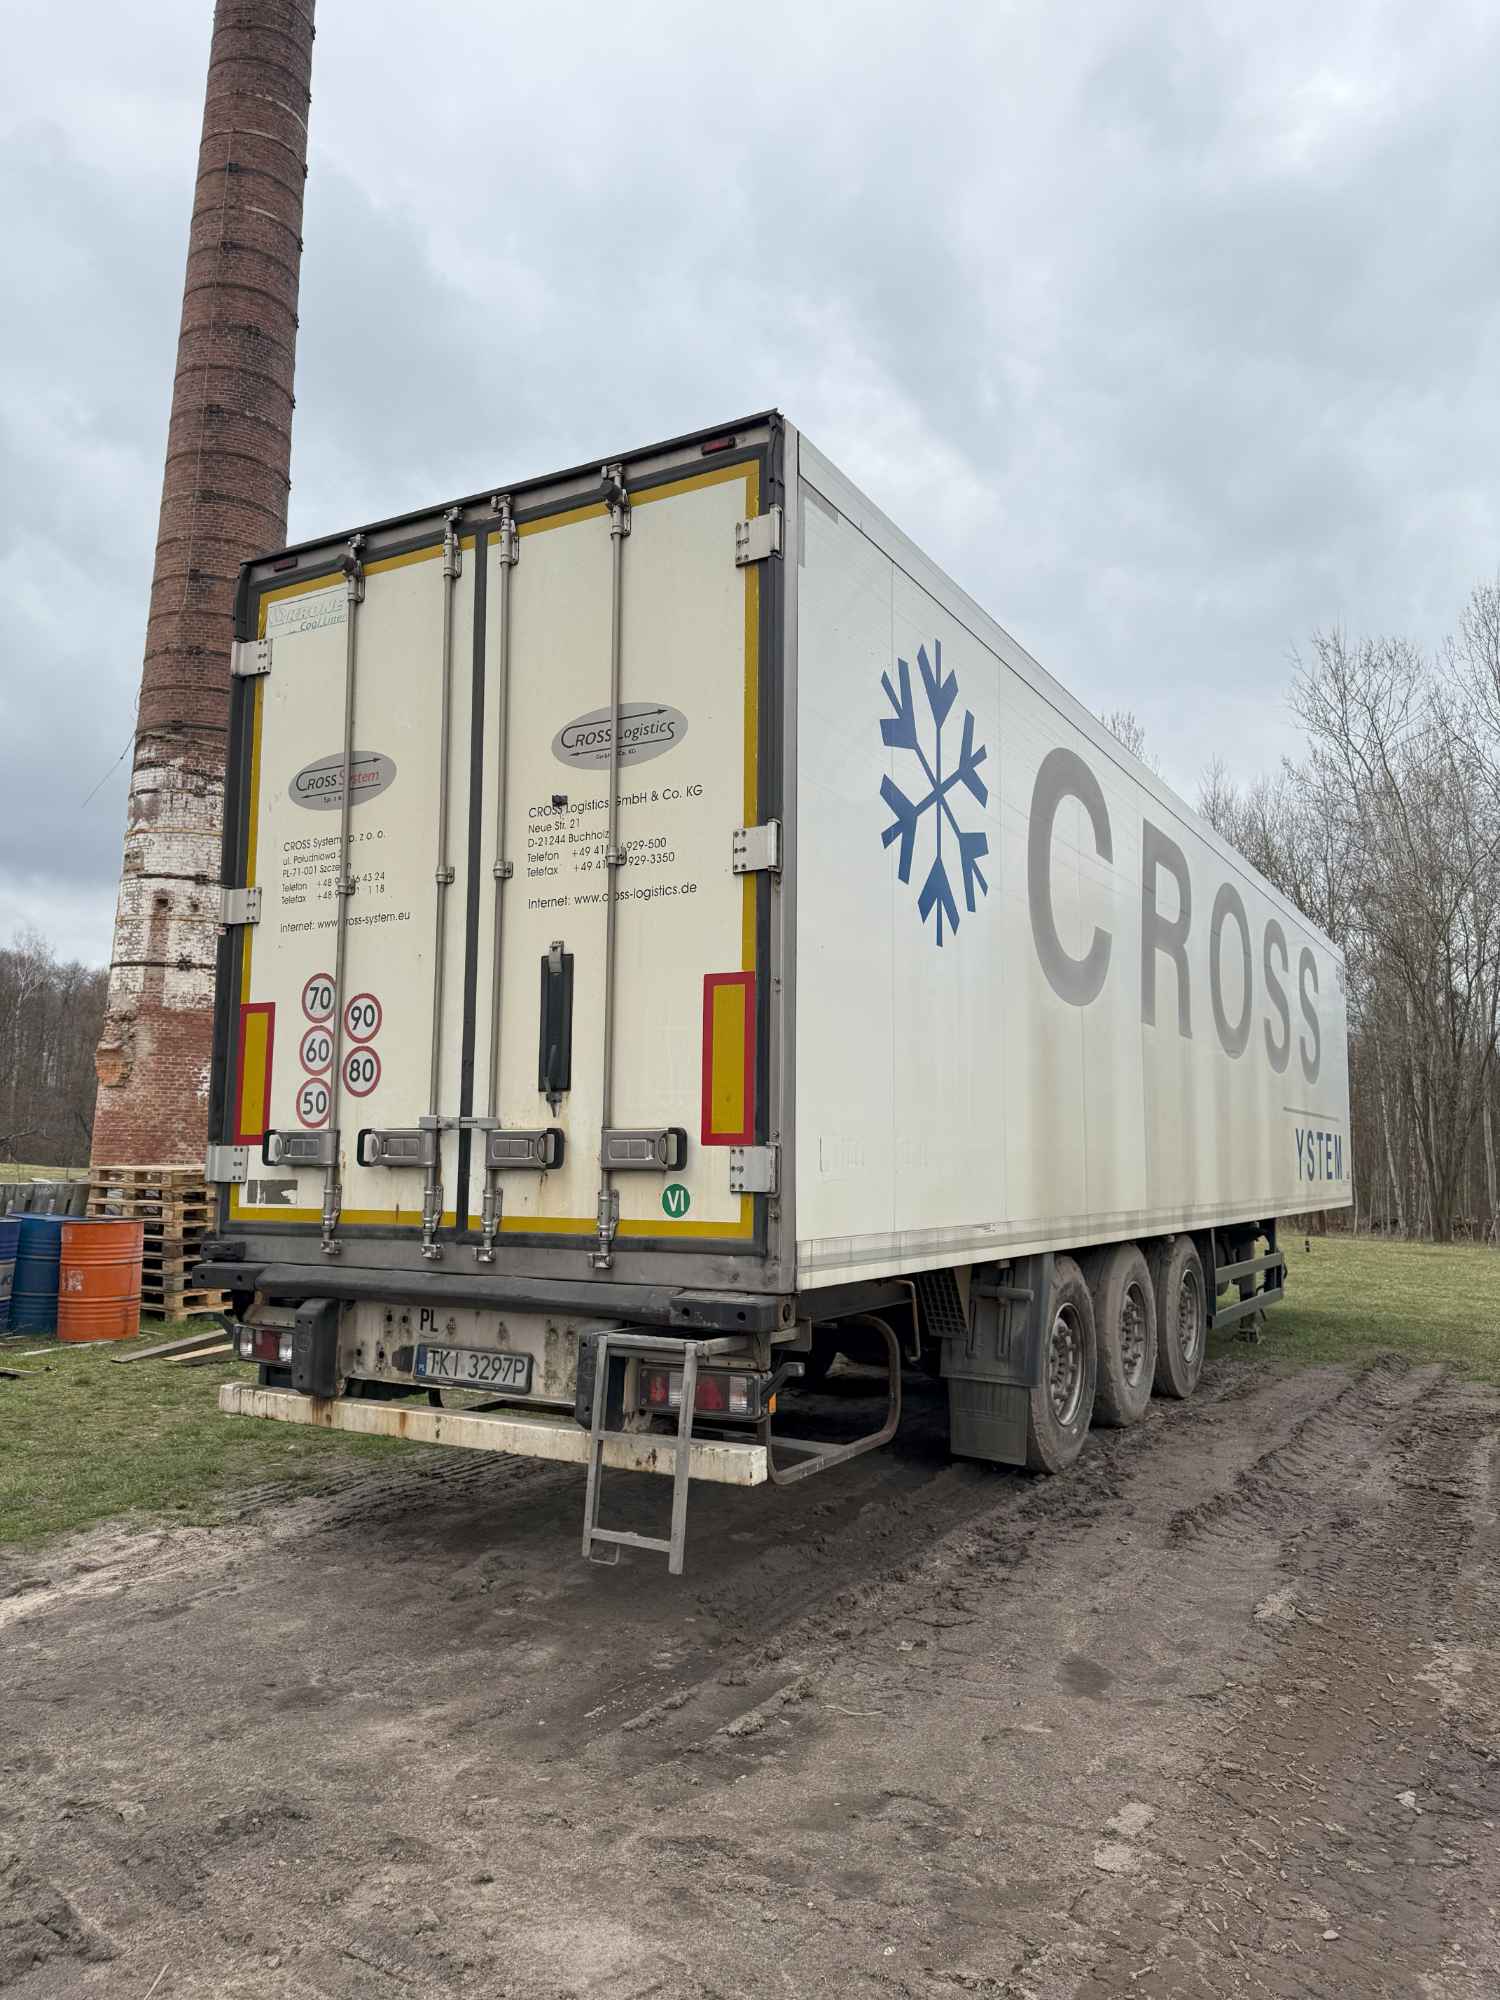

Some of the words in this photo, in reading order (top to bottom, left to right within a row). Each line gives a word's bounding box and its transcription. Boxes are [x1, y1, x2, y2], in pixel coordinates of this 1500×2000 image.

[560, 726, 612, 749] CROSS
[616, 720, 676, 743] ogistics
[296, 771, 337, 791] CROSS
[338, 767, 380, 786] Sstem
[528, 804, 563, 819] CROSS
[566, 798, 609, 816] Logistics
[650, 790, 660, 802] &
[662, 788, 683, 801] Co.
[686, 784, 704, 798] KG
[528, 823, 552, 834] Neue
[554, 819, 567, 831] Str.
[570, 818, 580, 830] 21
[568, 828, 610, 844] Buchholz
[283, 839, 311, 852] CROSS
[527, 850, 560, 864] Telefon
[571, 846, 591, 858] +49
[527, 865, 558, 878] Telefax
[574, 860, 593, 873] +49
[281, 881, 308, 893] Telefon
[281, 894, 306, 905] Telefax
[527, 895, 571, 910] Internet:
[574, 881, 698, 905] www.coss-logistics.de
[1027, 747, 1321, 1085] CROSS
[308, 986, 332, 1011] 70
[350, 1004, 376, 1031] 90
[305, 1038, 330, 1063] 60
[349, 1058, 375, 1083] 80
[302, 1090, 327, 1115] 50
[666, 1189, 685, 1213] VI
[419, 1308, 439, 1333] PL
